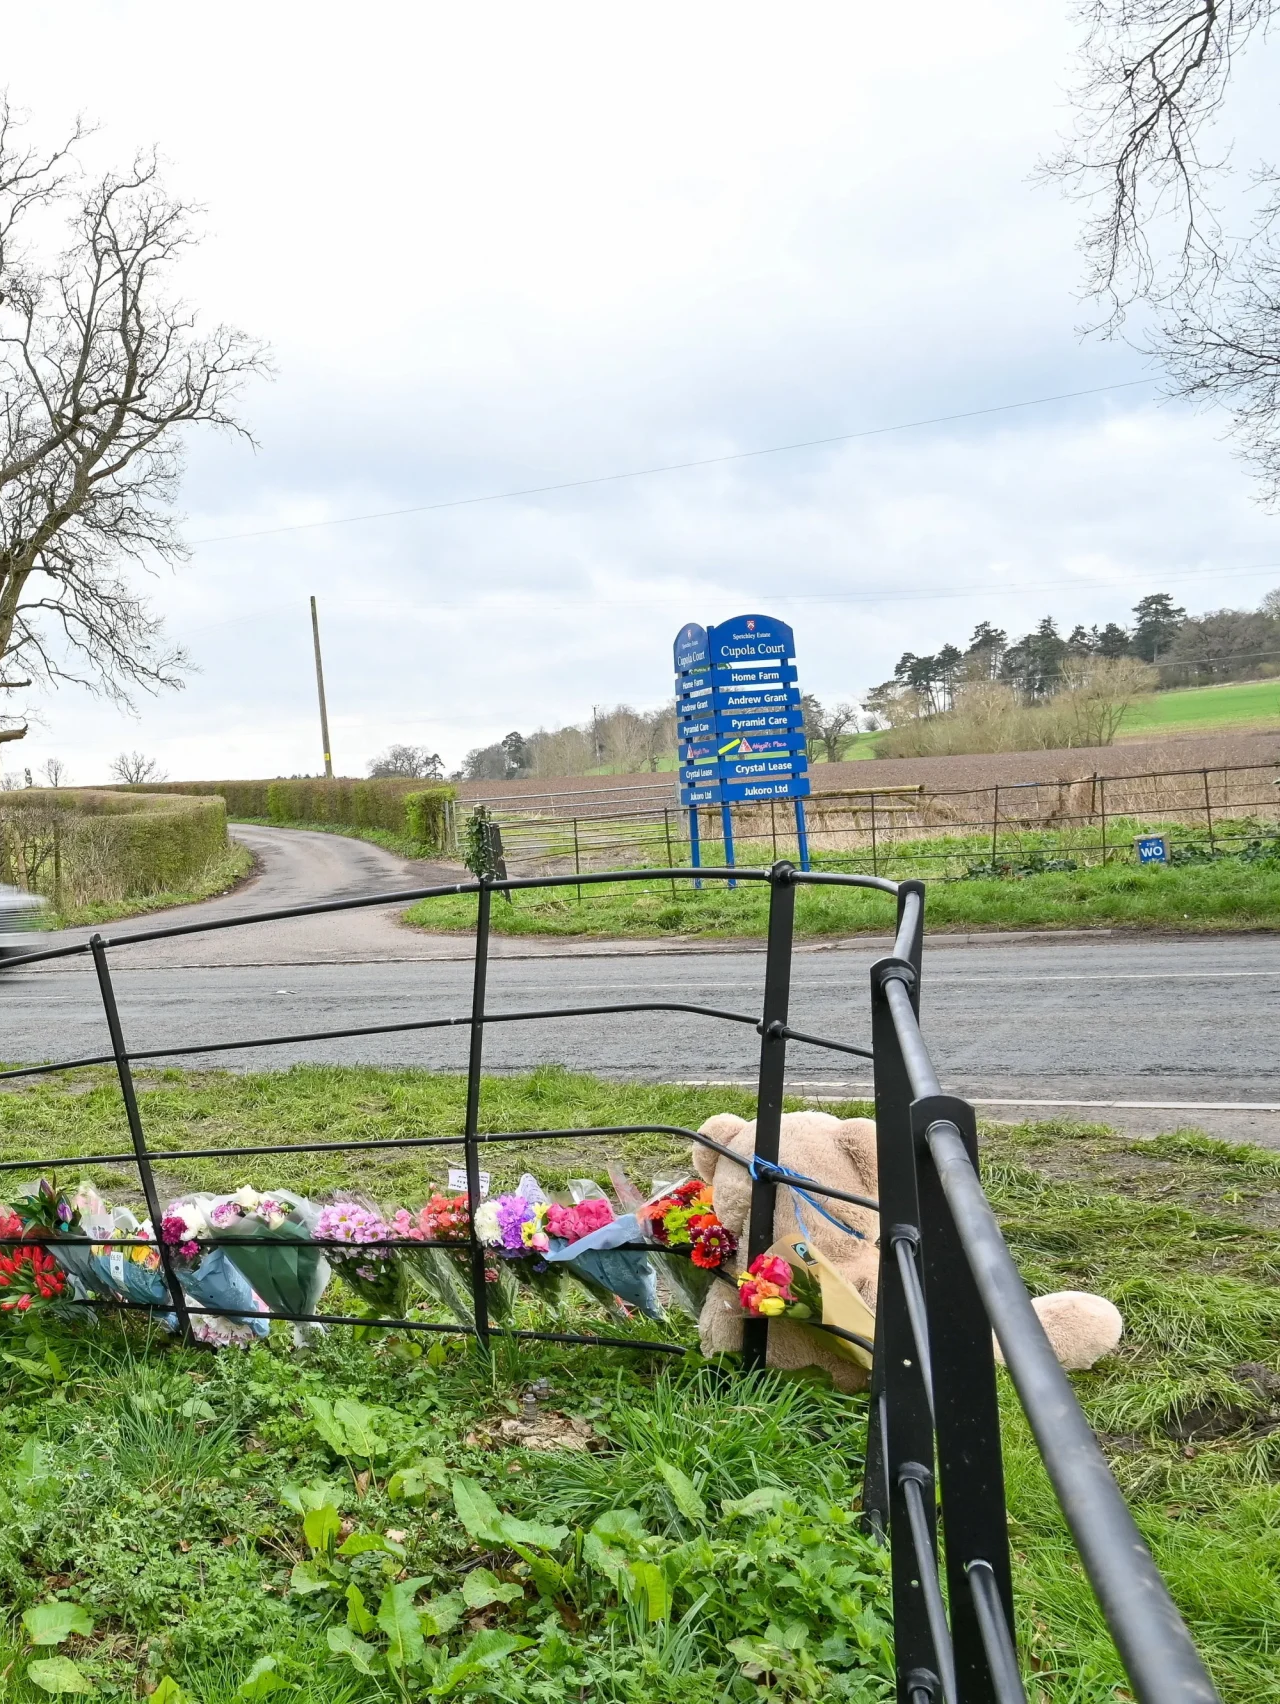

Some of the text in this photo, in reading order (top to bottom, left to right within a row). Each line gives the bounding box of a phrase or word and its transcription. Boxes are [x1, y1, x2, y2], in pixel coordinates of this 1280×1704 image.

[721, 643, 785, 658] Cupola Court
[678, 651, 705, 667] Cupola Court
[731, 671, 779, 682] Home Farm
[683, 679, 704, 690] Home Farm
[728, 693, 787, 705] Andrew Grant
[681, 700, 708, 712] Andrew Grant
[731, 716, 788, 729] Pyramid Care
[683, 723, 709, 736] Pyramid Care
[735, 762, 792, 774] Crystal Lease
[686, 769, 713, 780] Crystal Lease
[690, 791, 704, 801] Jukoro
[744, 784, 788, 796] Jukoro Ltd
[1141, 846, 1163, 857] WO
